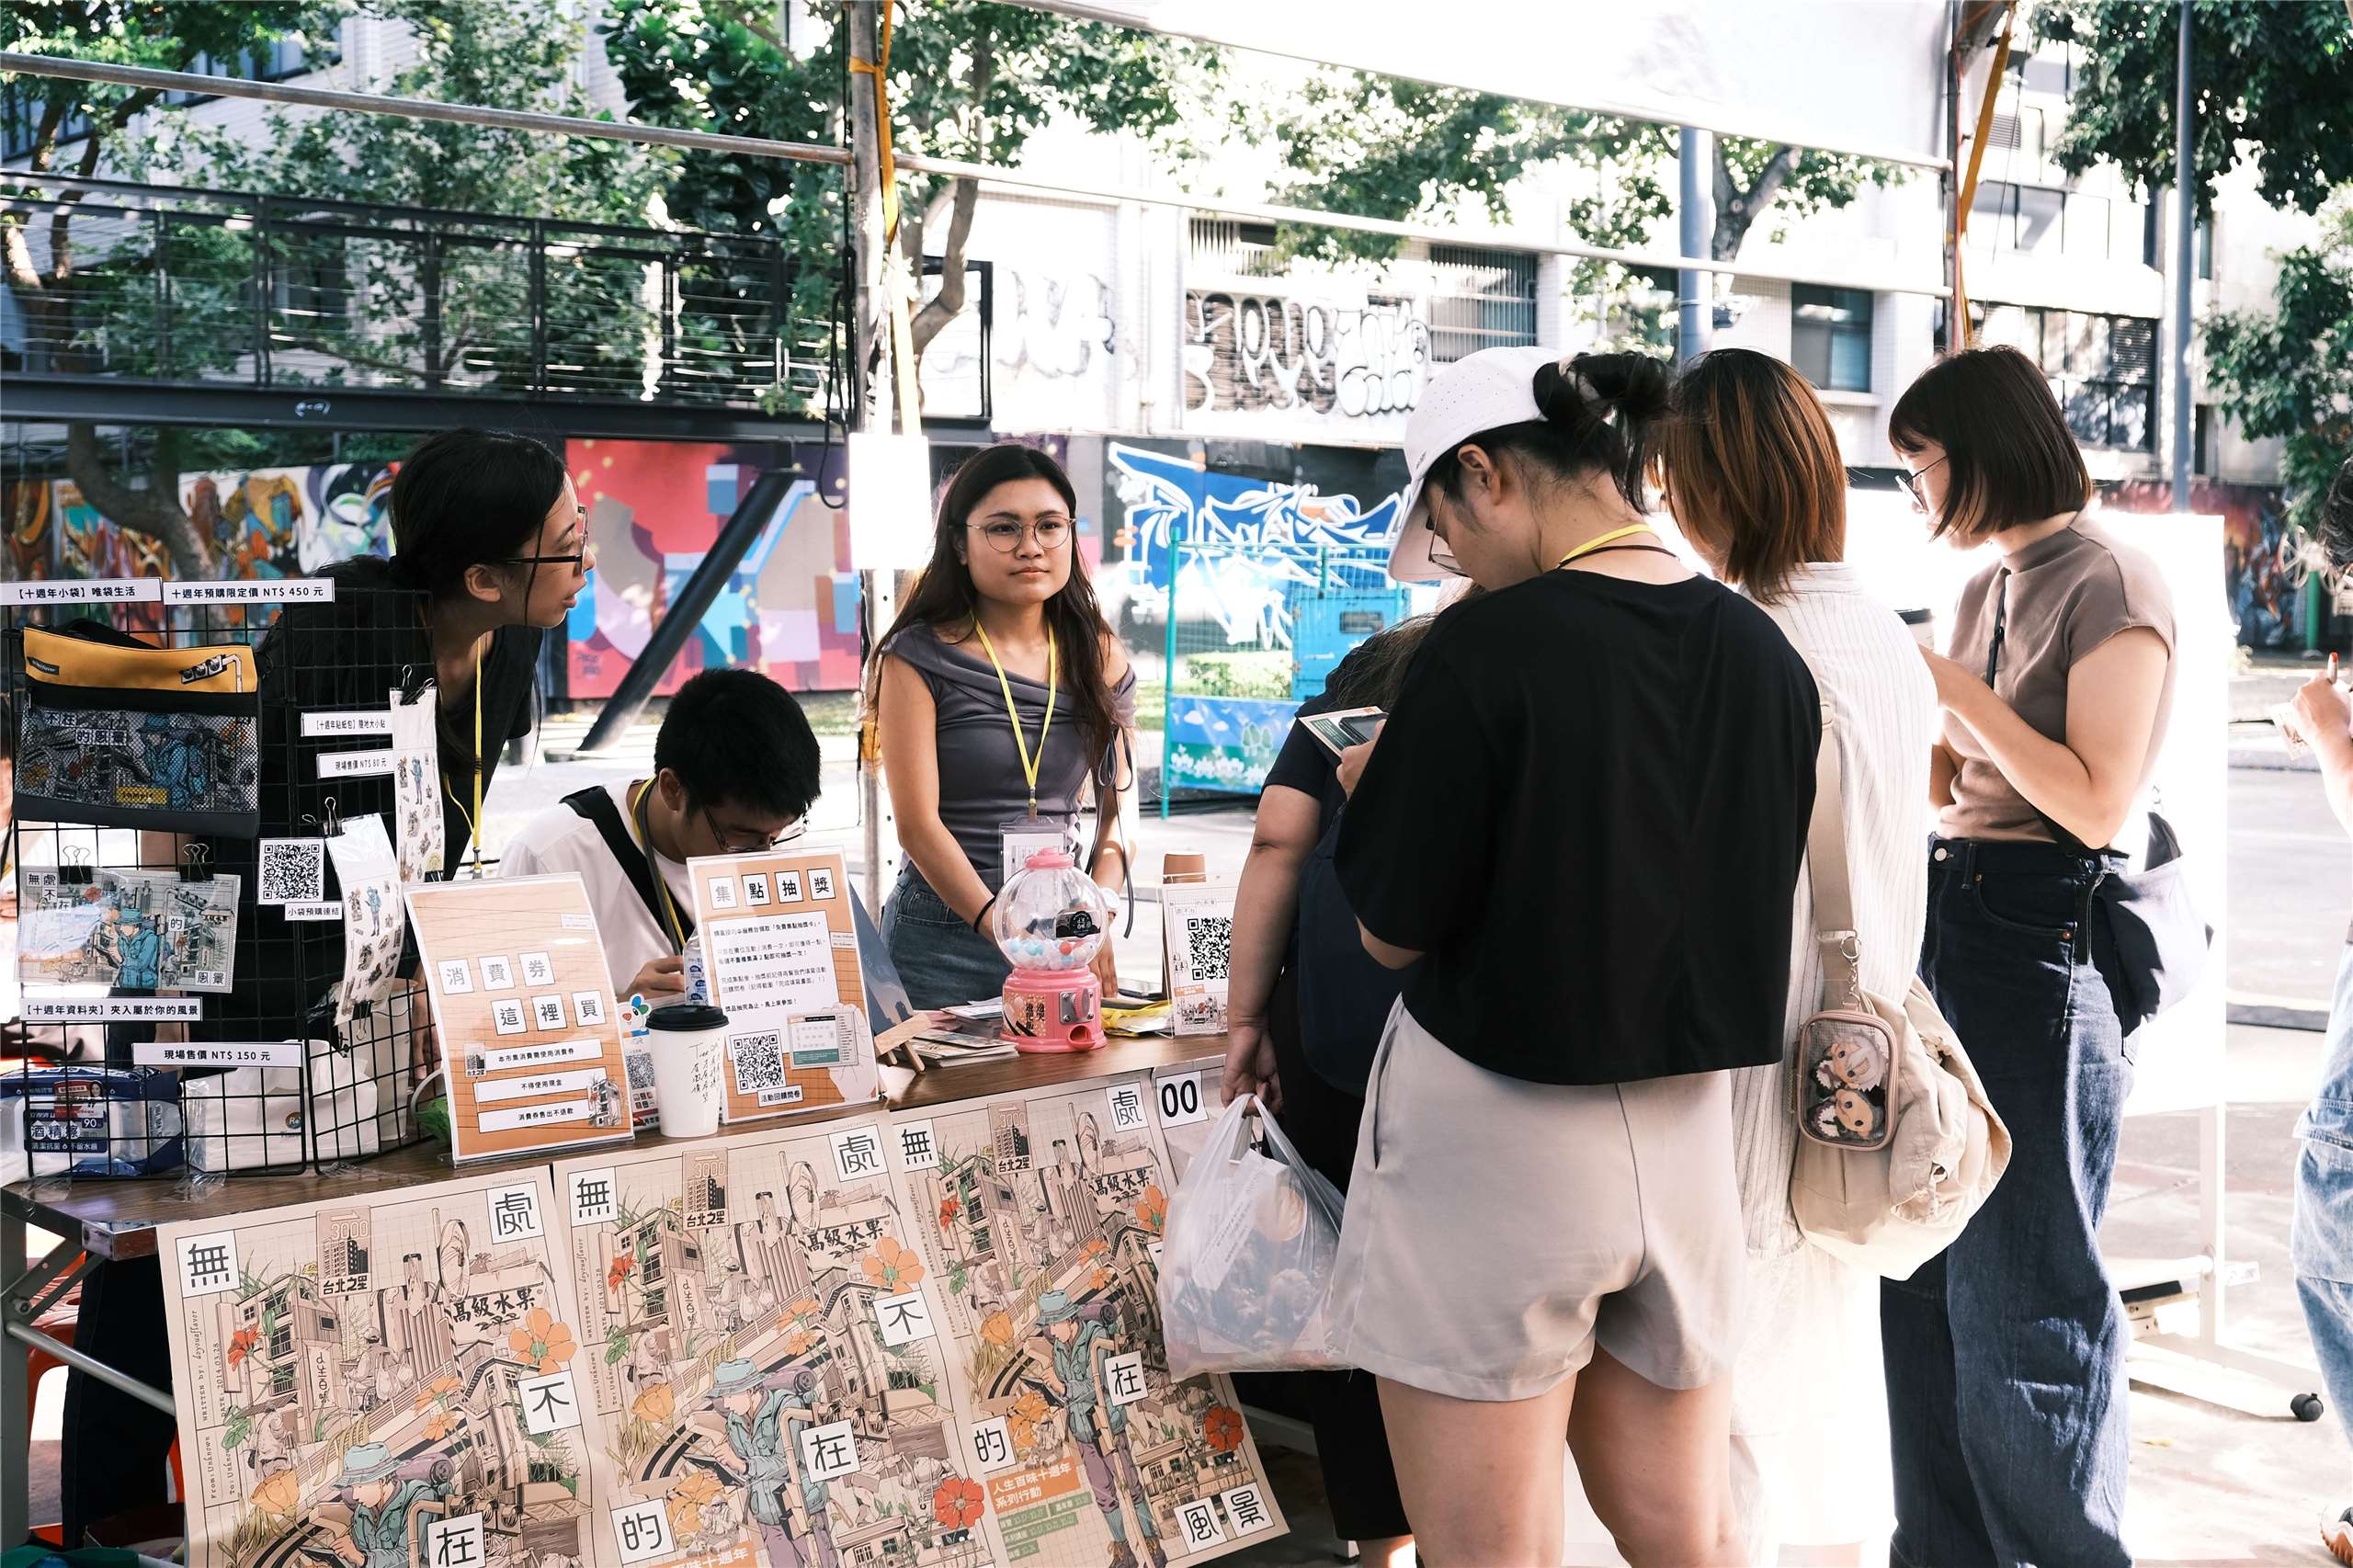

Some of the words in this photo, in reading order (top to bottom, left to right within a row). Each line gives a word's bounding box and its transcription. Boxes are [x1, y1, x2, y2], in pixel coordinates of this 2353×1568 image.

[18, 586, 136, 599] 【十週年小袋】唯袋生活
[171, 587, 259, 598] 十週年預購限定價
[263, 587, 285, 597] NT$
[289, 587, 310, 597] 450
[313, 586, 324, 597] 元
[715, 877, 830, 903] 集點抽獎
[289, 907, 339, 916] 小袋預購連結
[447, 959, 547, 986] 消費券
[26, 1005, 199, 1017] 【十週年資料夾】夾入屬於你的風景
[500, 998, 599, 1028] 這裡買
[164, 1050, 209, 1061] 現場售價
[211, 1051, 233, 1061] NT$
[236, 1050, 257, 1060] 150
[261, 1050, 270, 1061] 元
[521, 1079, 563, 1090] 不得使用現金
[1161, 1079, 1199, 1119] 00
[84, 1118, 97, 1128] 90
[1112, 1090, 1142, 1126] 處
[837, 1134, 877, 1175] 處
[902, 1128, 933, 1165] 無
[494, 1192, 538, 1236] 處
[577, 1177, 611, 1218] 無
[330, 1220, 369, 1241] 3000
[806, 1218, 885, 1253] 高級水果
[187, 1243, 231, 1288] 無
[452, 1289, 537, 1324] 高級水果
[887, 1300, 924, 1336] 不
[1112, 1361, 1143, 1397] 在
[530, 1381, 571, 1424] 不
[809, 1433, 852, 1471] 在
[974, 1427, 1004, 1464] 的
[994, 1462, 1072, 1494] 人生百味十週年
[995, 1485, 1042, 1509] 系列行動
[620, 1512, 663, 1551] 的
[1186, 1490, 1267, 1543] 風景
[435, 1527, 477, 1568] 在
